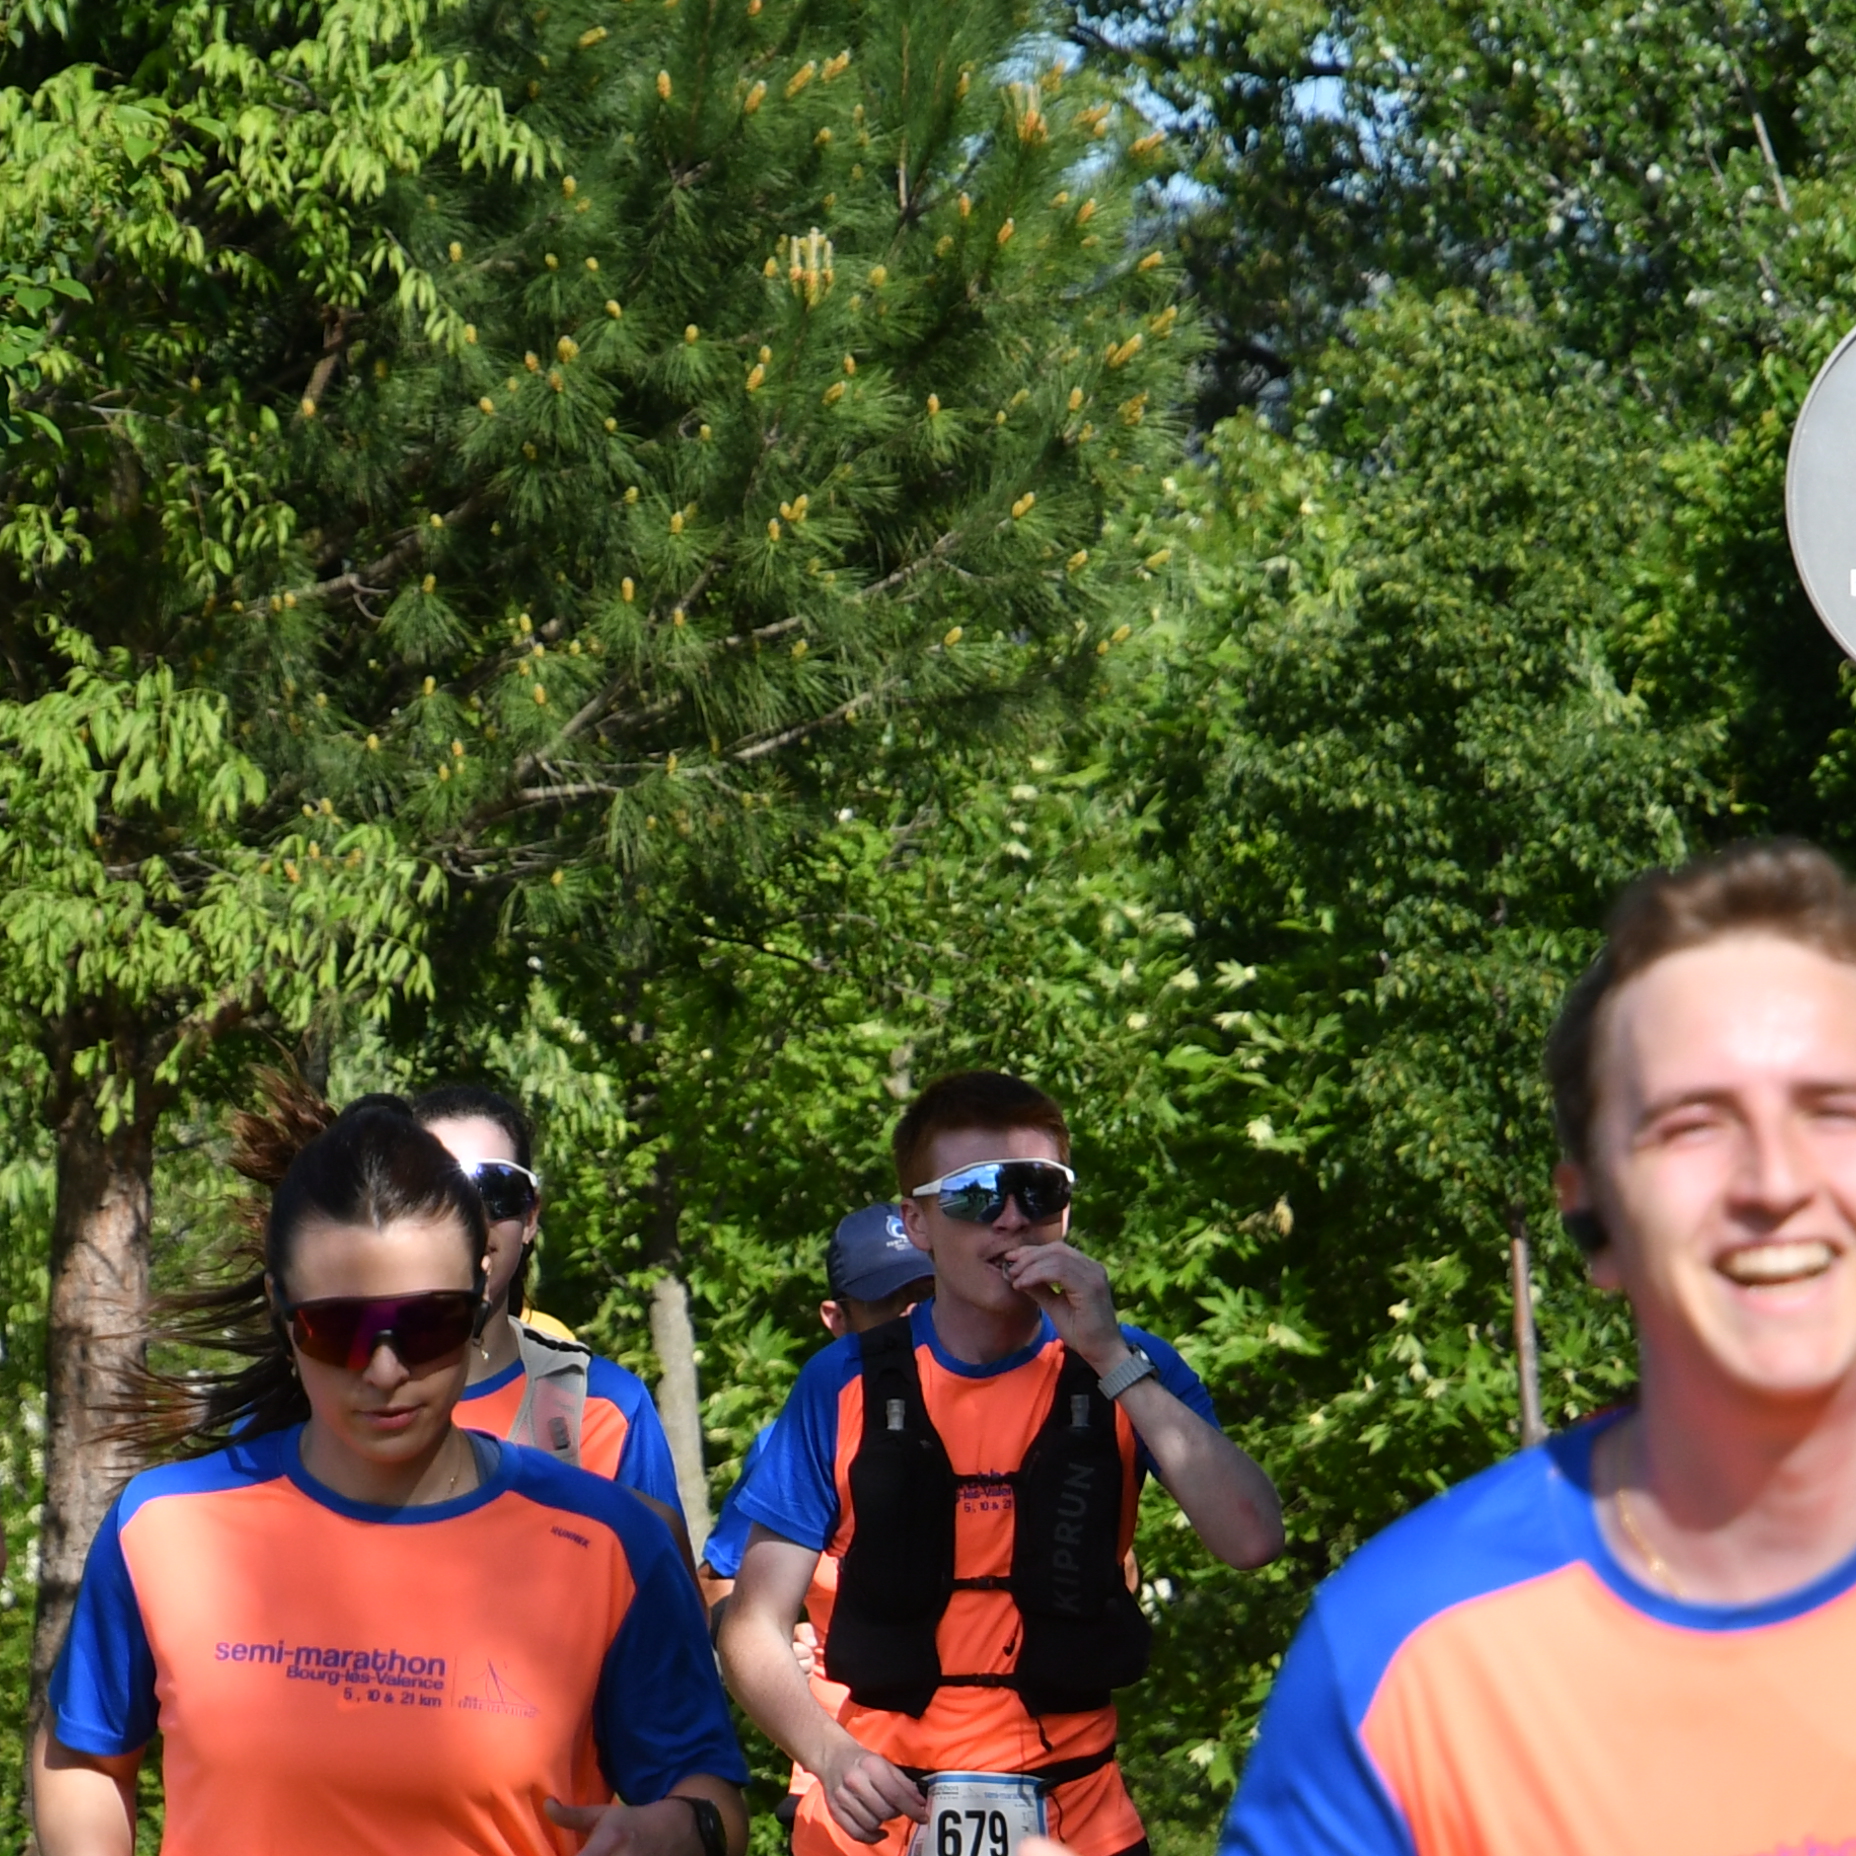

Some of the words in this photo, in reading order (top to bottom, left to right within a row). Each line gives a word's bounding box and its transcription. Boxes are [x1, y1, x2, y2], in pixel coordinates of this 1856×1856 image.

[1053, 1462, 1095, 1614] KIPRUN
[215, 1640, 446, 1676] semi-marathon
[368, 1689, 380, 1703] 10
[401, 1691, 414, 1705] 21
[420, 1693, 441, 1707] km
